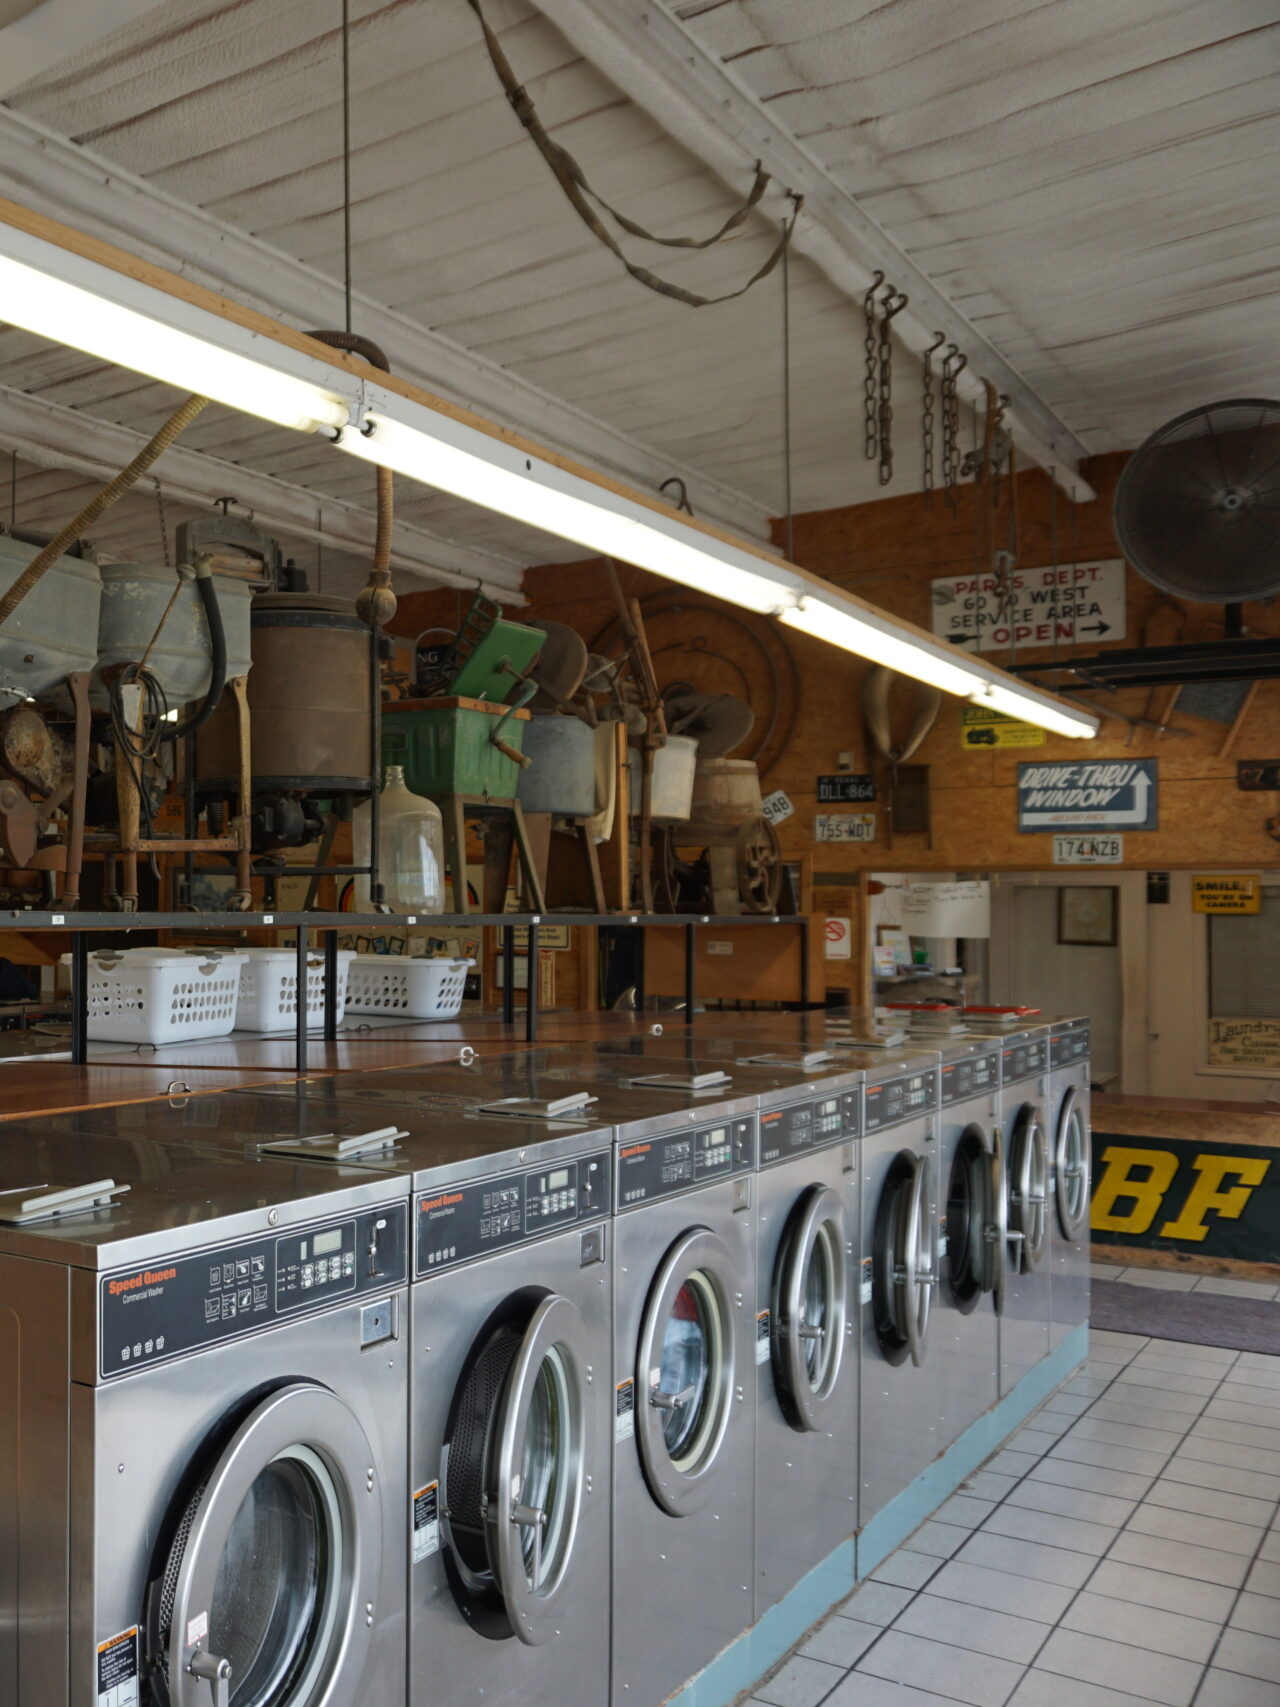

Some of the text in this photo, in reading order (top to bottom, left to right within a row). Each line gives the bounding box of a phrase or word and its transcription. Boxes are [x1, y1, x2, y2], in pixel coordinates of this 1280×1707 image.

[1043, 567, 1104, 586] DEPT.
[964, 597, 987, 610] GO
[1031, 586, 1089, 603] WEST
[951, 602, 1102, 628] SERVICE AREA
[993, 622, 1074, 643] OPEN
[1019, 764, 1137, 788] DRIVE-THRU
[763, 797, 790, 819] 948
[1024, 788, 1121, 808] WINDOW
[1059, 840, 1119, 857] 174 NZB
[421, 1193, 464, 1212] Speed Queen
[108, 1267, 177, 1296] Speed Queen
[123, 1286, 164, 1304] Commercial Washer
